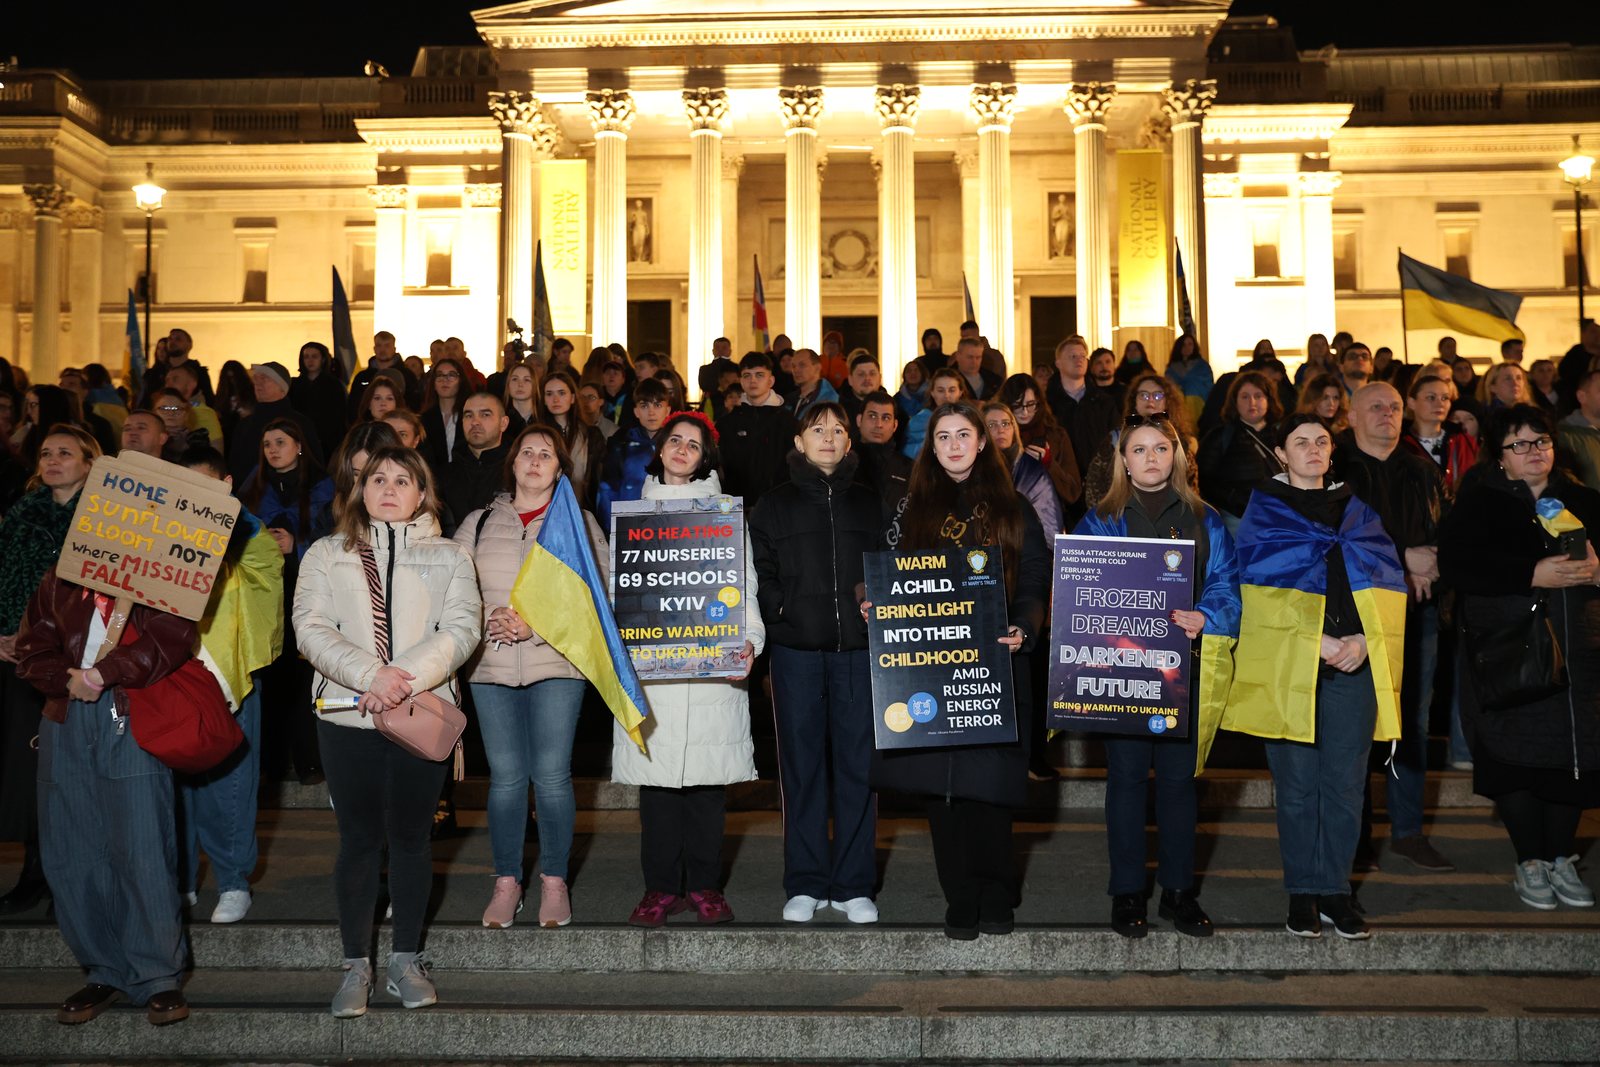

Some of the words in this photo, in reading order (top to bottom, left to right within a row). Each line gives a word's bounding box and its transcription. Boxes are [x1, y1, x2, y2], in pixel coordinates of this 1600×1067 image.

[1130, 177, 1142, 259] NATIONAL
[1144, 178, 1158, 259] GALLERY
[553, 190, 564, 270] NATIONAL
[566, 190, 579, 270] GALLERY
[102, 472, 168, 505] HOME
[175, 495, 188, 511] is
[192, 503, 234, 530] where
[77, 516, 154, 552] BLOOM
[628, 528, 654, 541] NO
[658, 525, 733, 540] HEATING
[621, 550, 640, 563] 77
[644, 546, 736, 562] NURSERIES
[895, 555, 946, 570] WARM
[72, 542, 120, 564] where
[120, 554, 214, 595] MISSILES
[1061, 566, 1095, 574] FEBRUARY
[619, 572, 642, 588] 69
[646, 570, 738, 586] SCHOOLS
[890, 580, 903, 595] A
[904, 578, 955, 594] CHILD.
[660, 596, 706, 612] KYIV
[1076, 586, 1166, 610] FROZEN
[876, 603, 926, 620] BRING
[928, 601, 974, 616] LIGHT
[619, 627, 663, 640] BRING
[666, 624, 738, 638] WARMTH
[884, 628, 922, 643] INTO
[923, 625, 971, 640] THEIR
[1072, 614, 1168, 638] DREAMS
[631, 648, 652, 660] TO
[656, 646, 724, 659] UKRAINE
[879, 648, 979, 668] CHILDHOOD!
[1060, 644, 1181, 669] DARKENED
[952, 667, 990, 680] AMID
[943, 682, 1002, 696] RUSSIAN
[1076, 676, 1162, 700] FUTURE
[946, 698, 1000, 712] ENERGY
[1053, 701, 1082, 710] BRING
[1082, 703, 1124, 713] WARMTH
[1126, 705, 1138, 713] TO
[1140, 706, 1179, 716] UKRAINE
[947, 714, 1002, 728] TERROR
